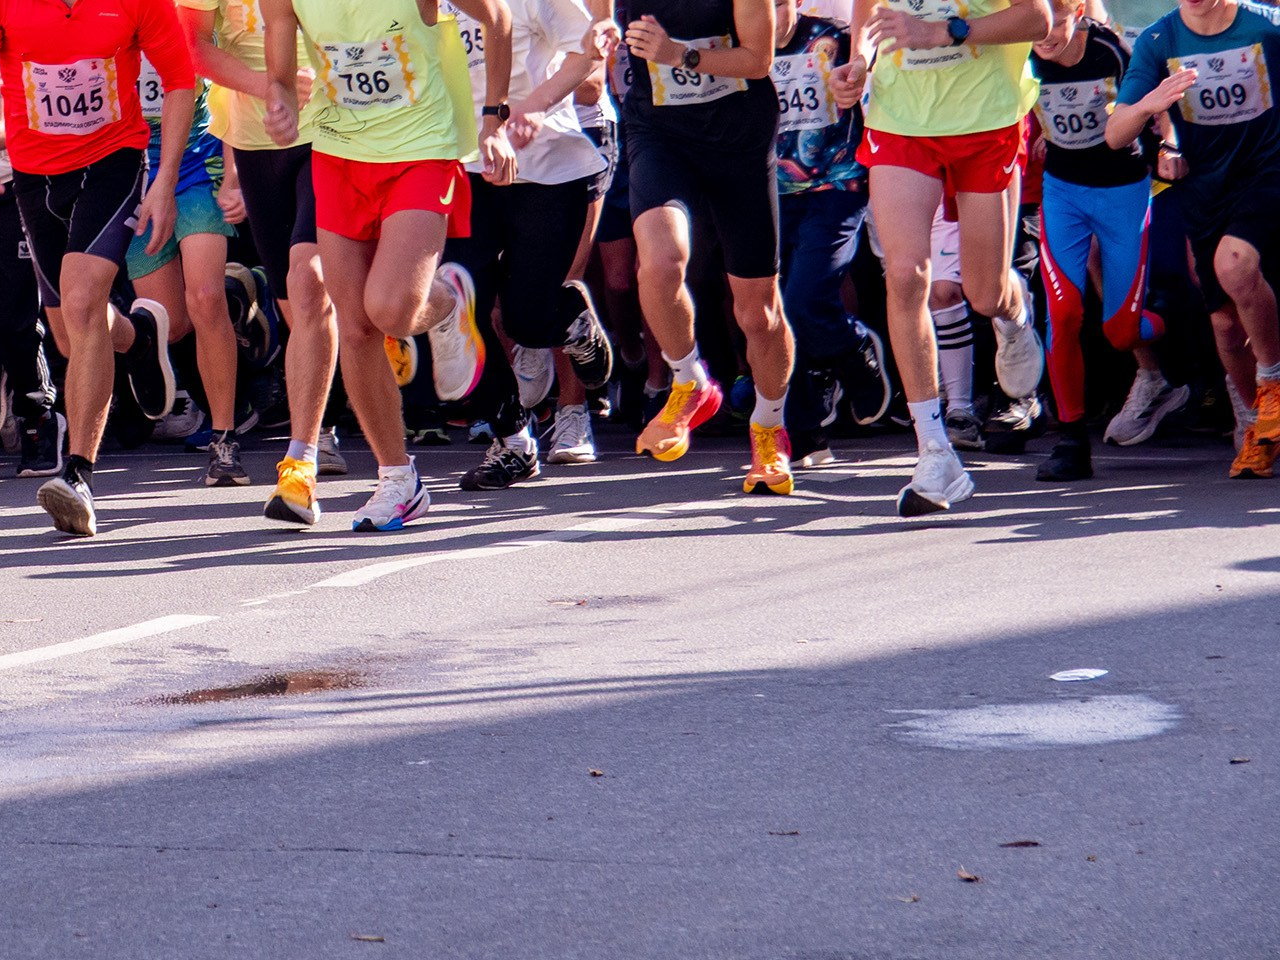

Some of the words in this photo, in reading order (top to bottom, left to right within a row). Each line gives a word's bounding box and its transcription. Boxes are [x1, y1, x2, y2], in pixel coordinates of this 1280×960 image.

[460, 28, 484, 54] 35
[135, 80, 164, 102] 13
[338, 71, 389, 95] 786
[1200, 83, 1246, 109] 609
[41, 88, 104, 117] 1045
[778, 87, 819, 115] 543
[1053, 111, 1099, 134] 603
